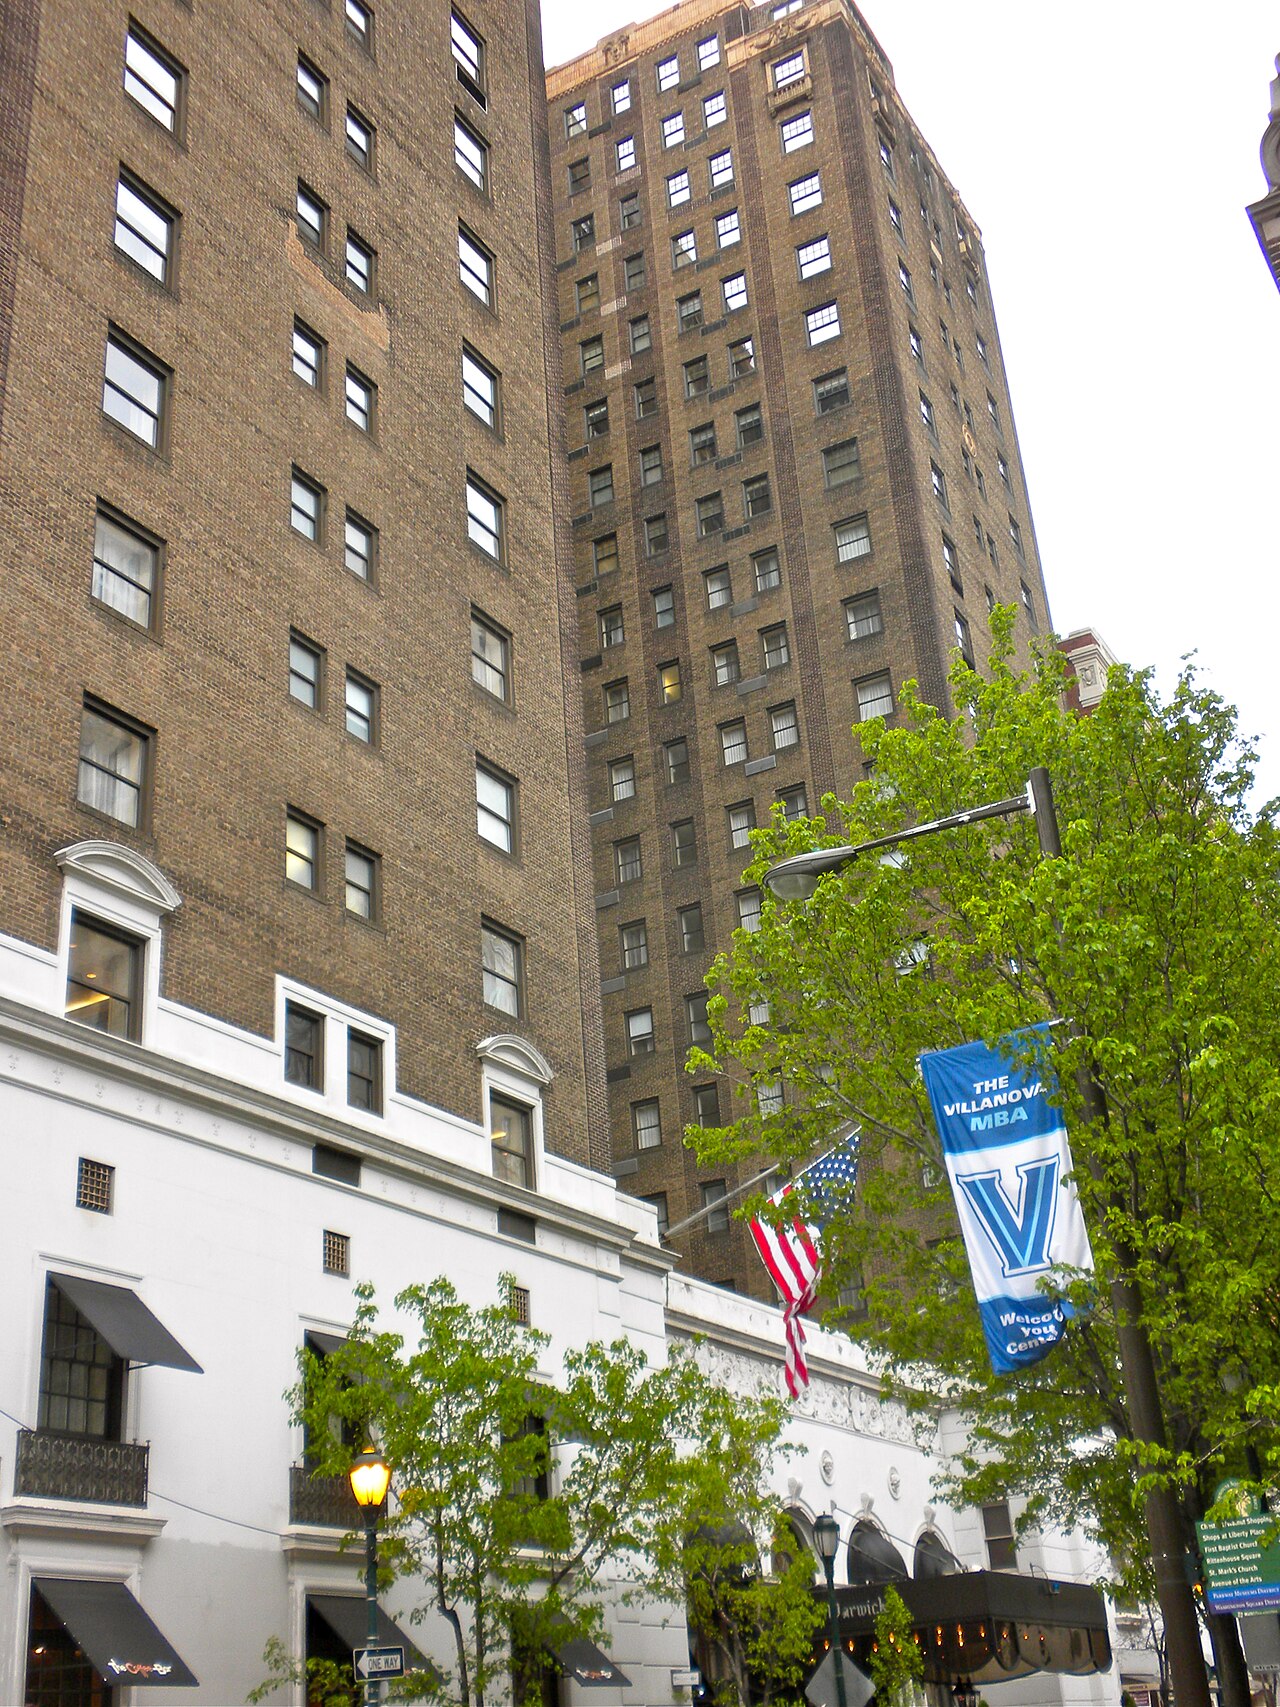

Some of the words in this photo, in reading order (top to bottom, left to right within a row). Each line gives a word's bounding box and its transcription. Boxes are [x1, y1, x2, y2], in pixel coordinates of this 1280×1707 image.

[973, 1075, 1009, 1095] THE
[943, 1082, 1048, 1117] VILLANOVA
[970, 1106, 1029, 1132] MBA
[956, 1153, 1061, 1279] V
[1021, 1324, 1058, 1338] you
[1202, 1533, 1221, 1542] Shops
[1221, 1532, 1228, 1540] at
[1228, 1530, 1249, 1539] Liberty
[1249, 1528, 1266, 1536] Place
[1204, 1545, 1218, 1554] First
[1217, 1543, 1239, 1552] Baptist
[1206, 1556, 1240, 1565] Rittenhouse
[1240, 1552, 1262, 1561] Square
[1208, 1568, 1218, 1577] St.
[1218, 1566, 1238, 1575] Mark's
[1237, 1564, 1258, 1573] Church
[1211, 1580, 1232, 1588] Avenue
[1239, 1577, 1250, 1585] the
[827, 1596, 889, 1619] arwick
[368, 1658, 383, 1671] ONE
[383, 1655, 399, 1669] WAY
